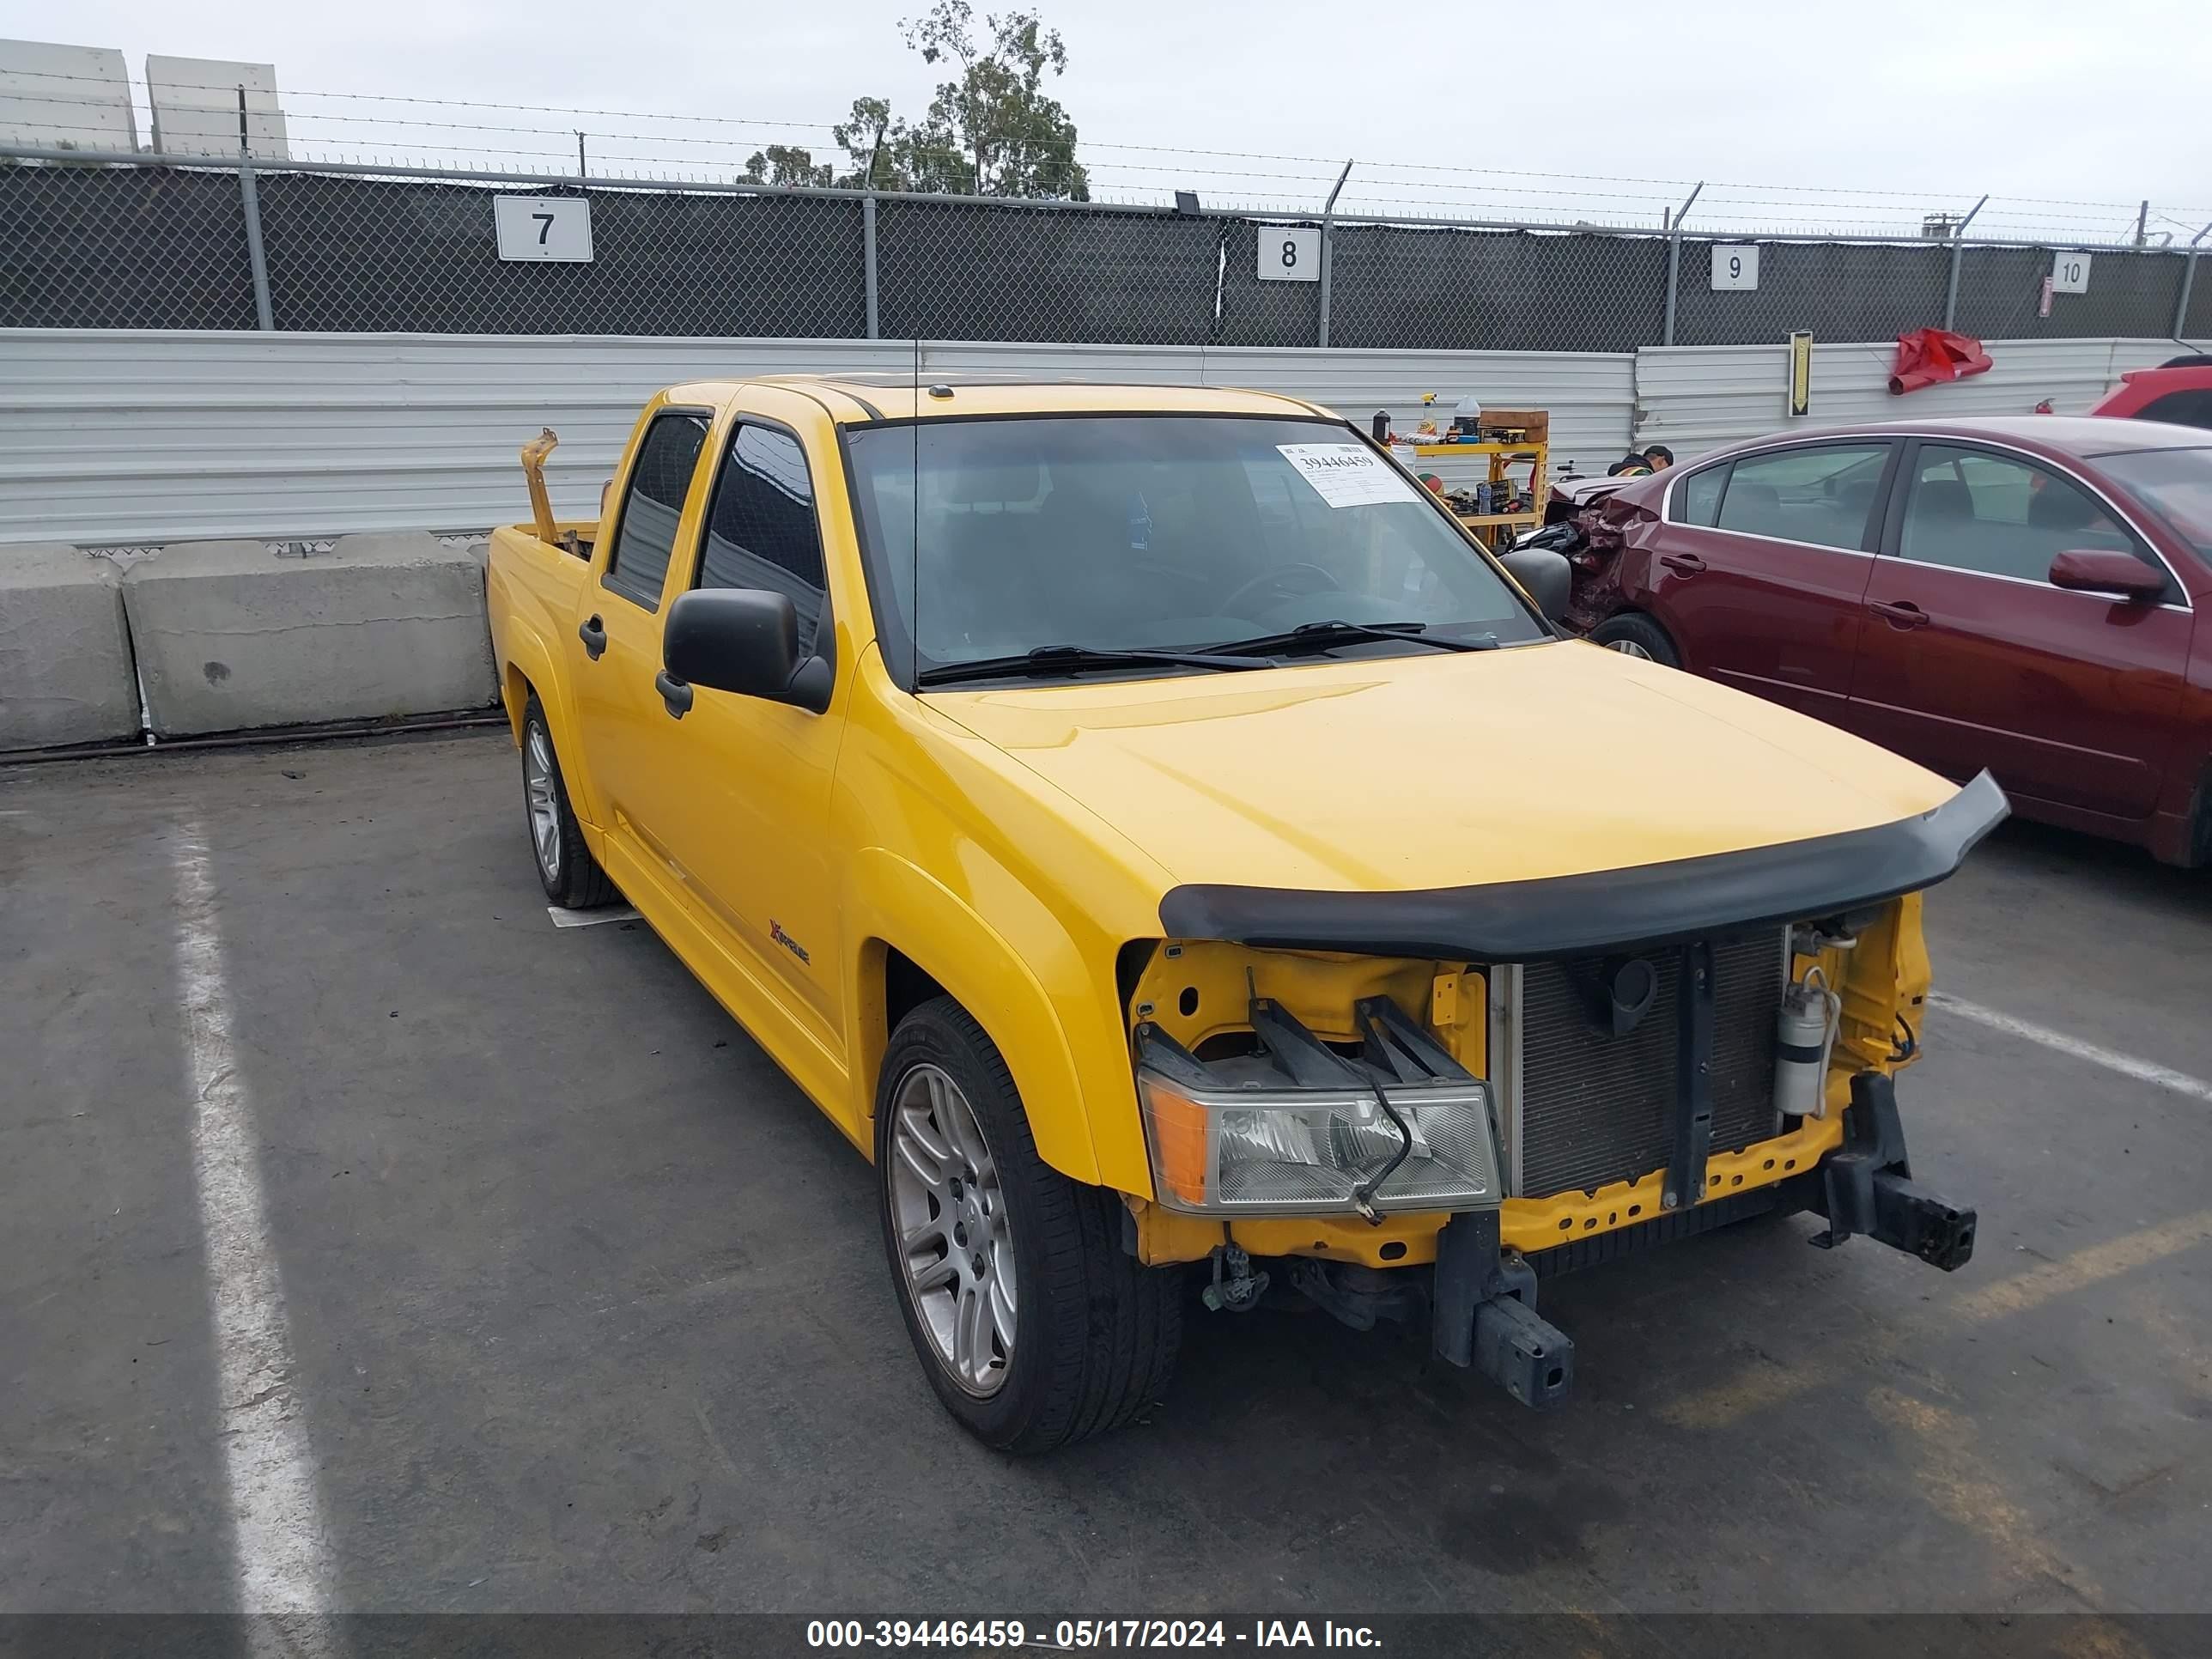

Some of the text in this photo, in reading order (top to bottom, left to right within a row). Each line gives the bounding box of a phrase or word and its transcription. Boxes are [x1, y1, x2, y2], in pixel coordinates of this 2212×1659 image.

[532, 214, 554, 244] 7
[1281, 240, 1297, 268] 8
[1729, 256, 1741, 279] 9
[2063, 262, 2081, 283] 10
[1300, 456, 1374, 470] 39446459
